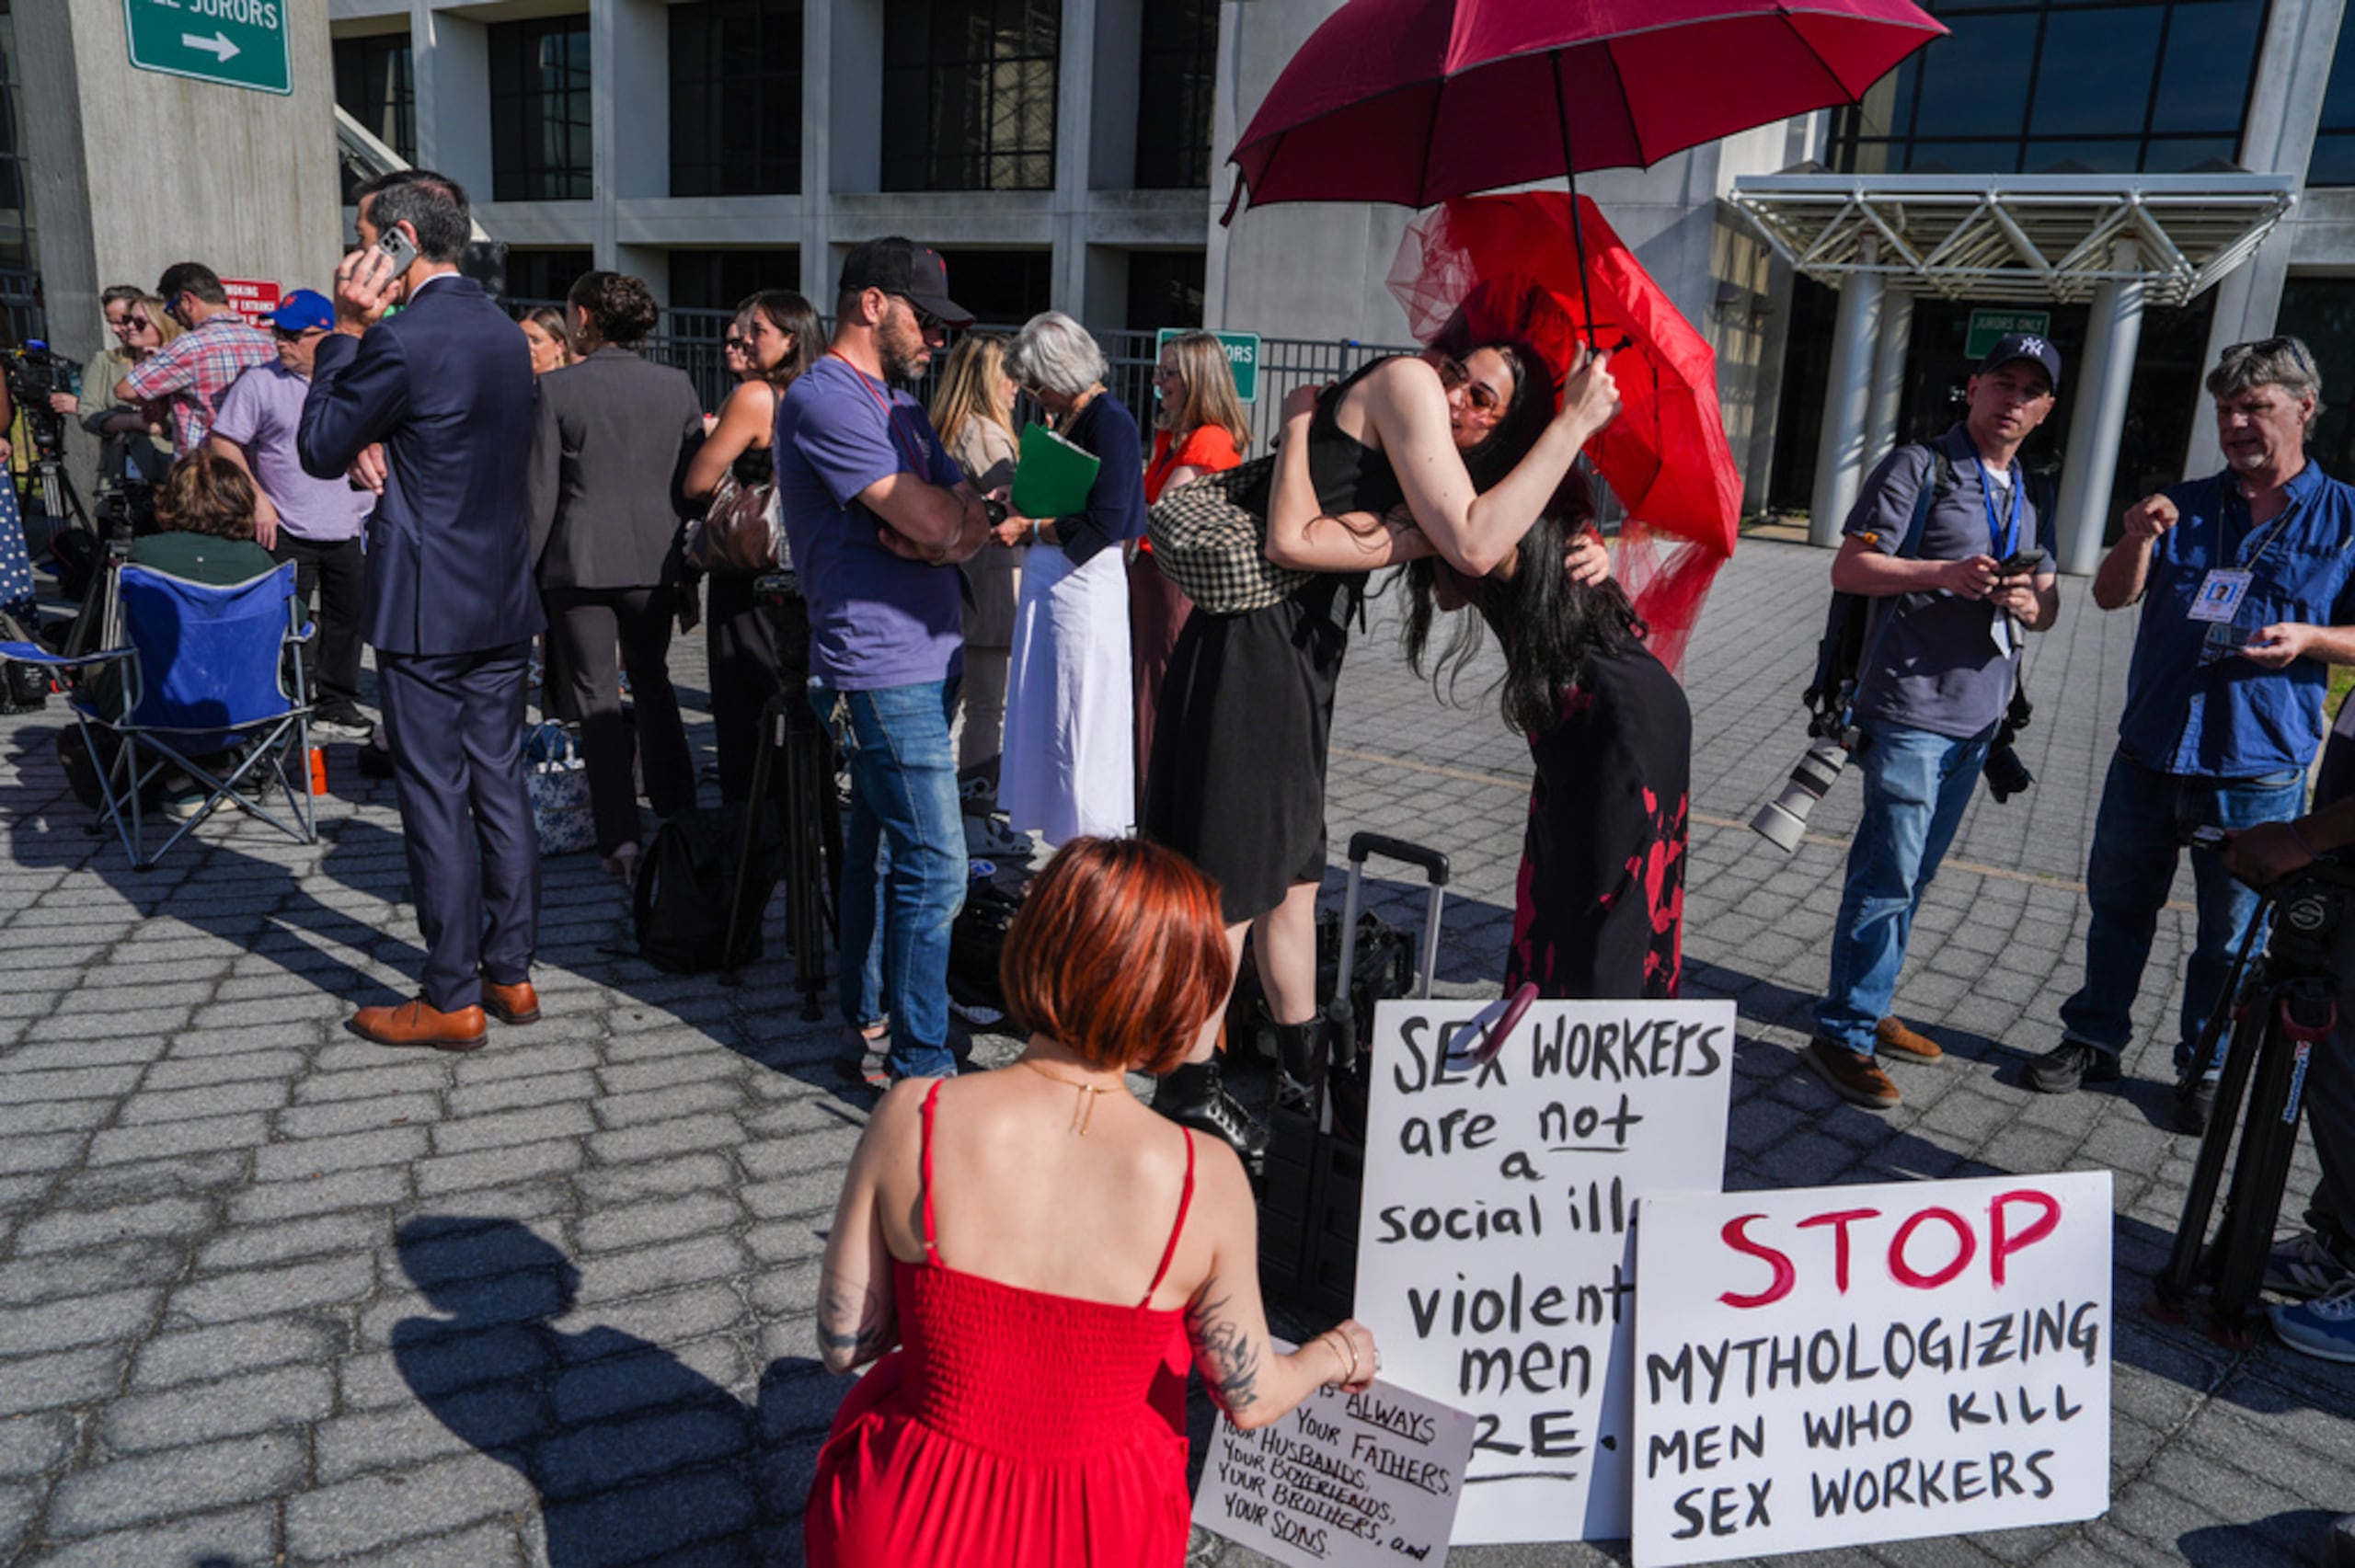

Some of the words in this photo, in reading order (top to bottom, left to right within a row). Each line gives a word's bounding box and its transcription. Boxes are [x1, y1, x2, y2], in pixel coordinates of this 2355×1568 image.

[1975, 316, 2015, 330] JURORS
[2017, 318, 2043, 332] ONLY
[1394, 1016, 1508, 1094] SEX
[1400, 1108, 1497, 1157] are
[1538, 1093, 1644, 1146] not
[1500, 1151, 1545, 1181] a
[1376, 1194, 1542, 1243] social
[1717, 1189, 2062, 1309] STOP
[1407, 1265, 1636, 1339] violent
[1460, 1341, 1591, 1398] men
[1647, 1299, 2098, 1404] MYTHOLOGIZING
[1297, 1407, 1340, 1447] YOUR
[1346, 1392, 1435, 1444] ALWAYS
[1648, 1414, 1764, 1479] MEN
[1804, 1399, 1913, 1448] WHO
[1948, 1384, 2083, 1432] KILL
[1223, 1437, 1265, 1471] YOUR
[1225, 1491, 1269, 1527] YOUR
[1671, 1478, 1773, 1539] SEX
[1812, 1449, 2055, 1517] WORKERS
[1390, 1536, 1431, 1562] and
